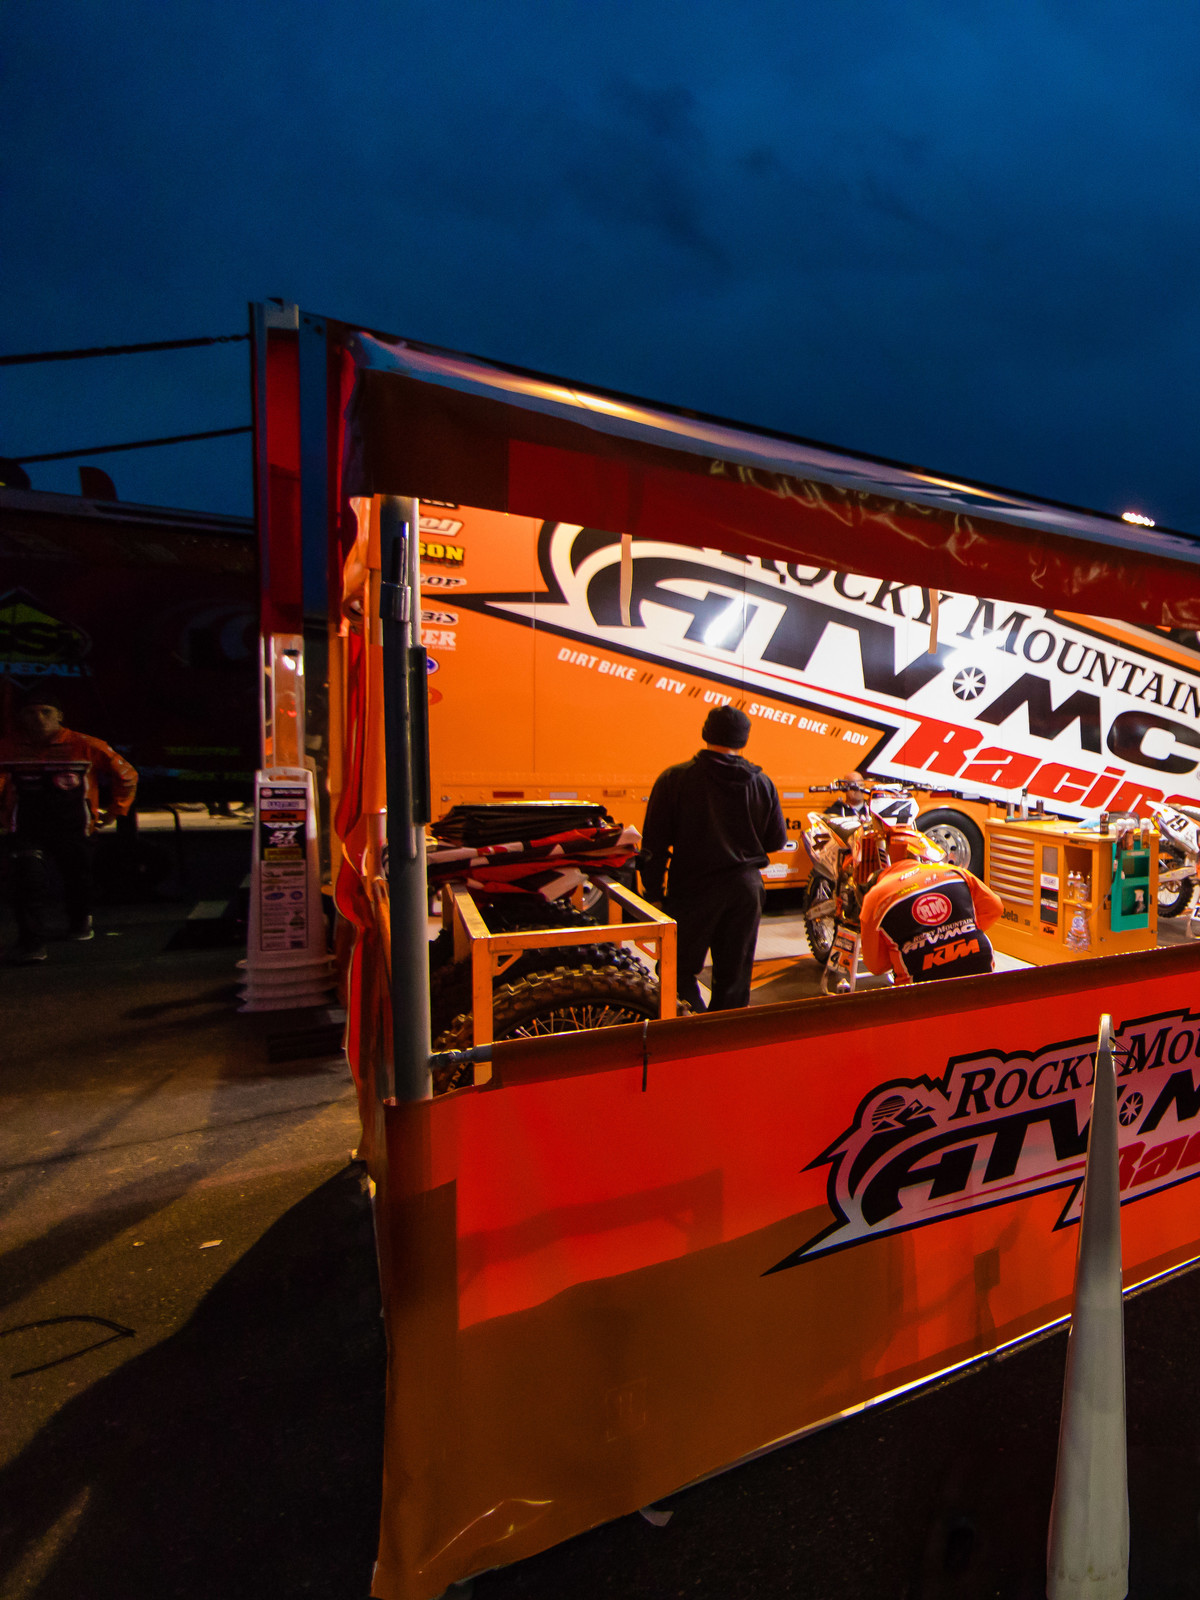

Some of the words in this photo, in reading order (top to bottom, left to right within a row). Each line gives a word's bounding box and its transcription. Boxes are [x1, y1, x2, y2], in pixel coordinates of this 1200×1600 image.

[586, 556, 955, 701] ATV
[557, 647, 599, 669] DIRT
[597, 660, 638, 681] BIKE
[655, 676, 687, 695] ATV
[703, 690, 732, 706] UTV
[749, 702, 797, 726] STREET
[797, 716, 829, 736] BIKE
[842, 730, 869, 747] ADV
[878, 800, 913, 824] 4
[1165, 814, 1190, 832] 19
[922, 937, 981, 971] KTM
